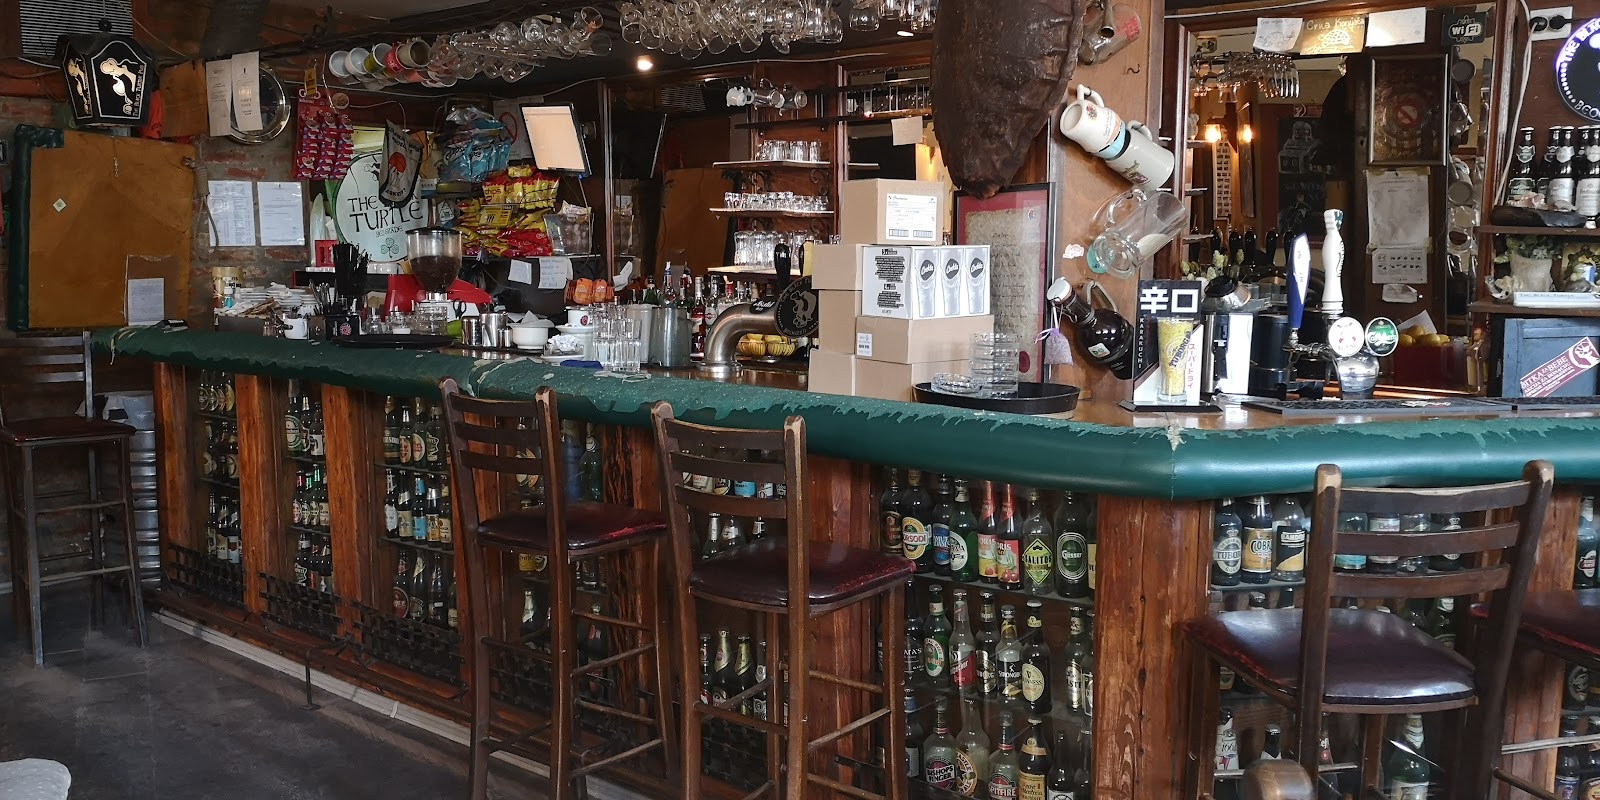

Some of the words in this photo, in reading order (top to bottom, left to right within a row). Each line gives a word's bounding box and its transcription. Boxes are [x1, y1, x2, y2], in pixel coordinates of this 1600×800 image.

[1306, 19, 1331, 31] Crna
[1561, 40, 1581, 62] THE
[347, 195, 379, 212] THE
[349, 200, 424, 233] TURTLE
[1140, 286, 1199, 314] 辛口
[1187, 343, 1197, 388] スーパードライ
[1547, 355, 1568, 372] BEBE
[926, 765, 954, 776] BISHOPS
[988, 786, 1016, 797] SPITFIRE
